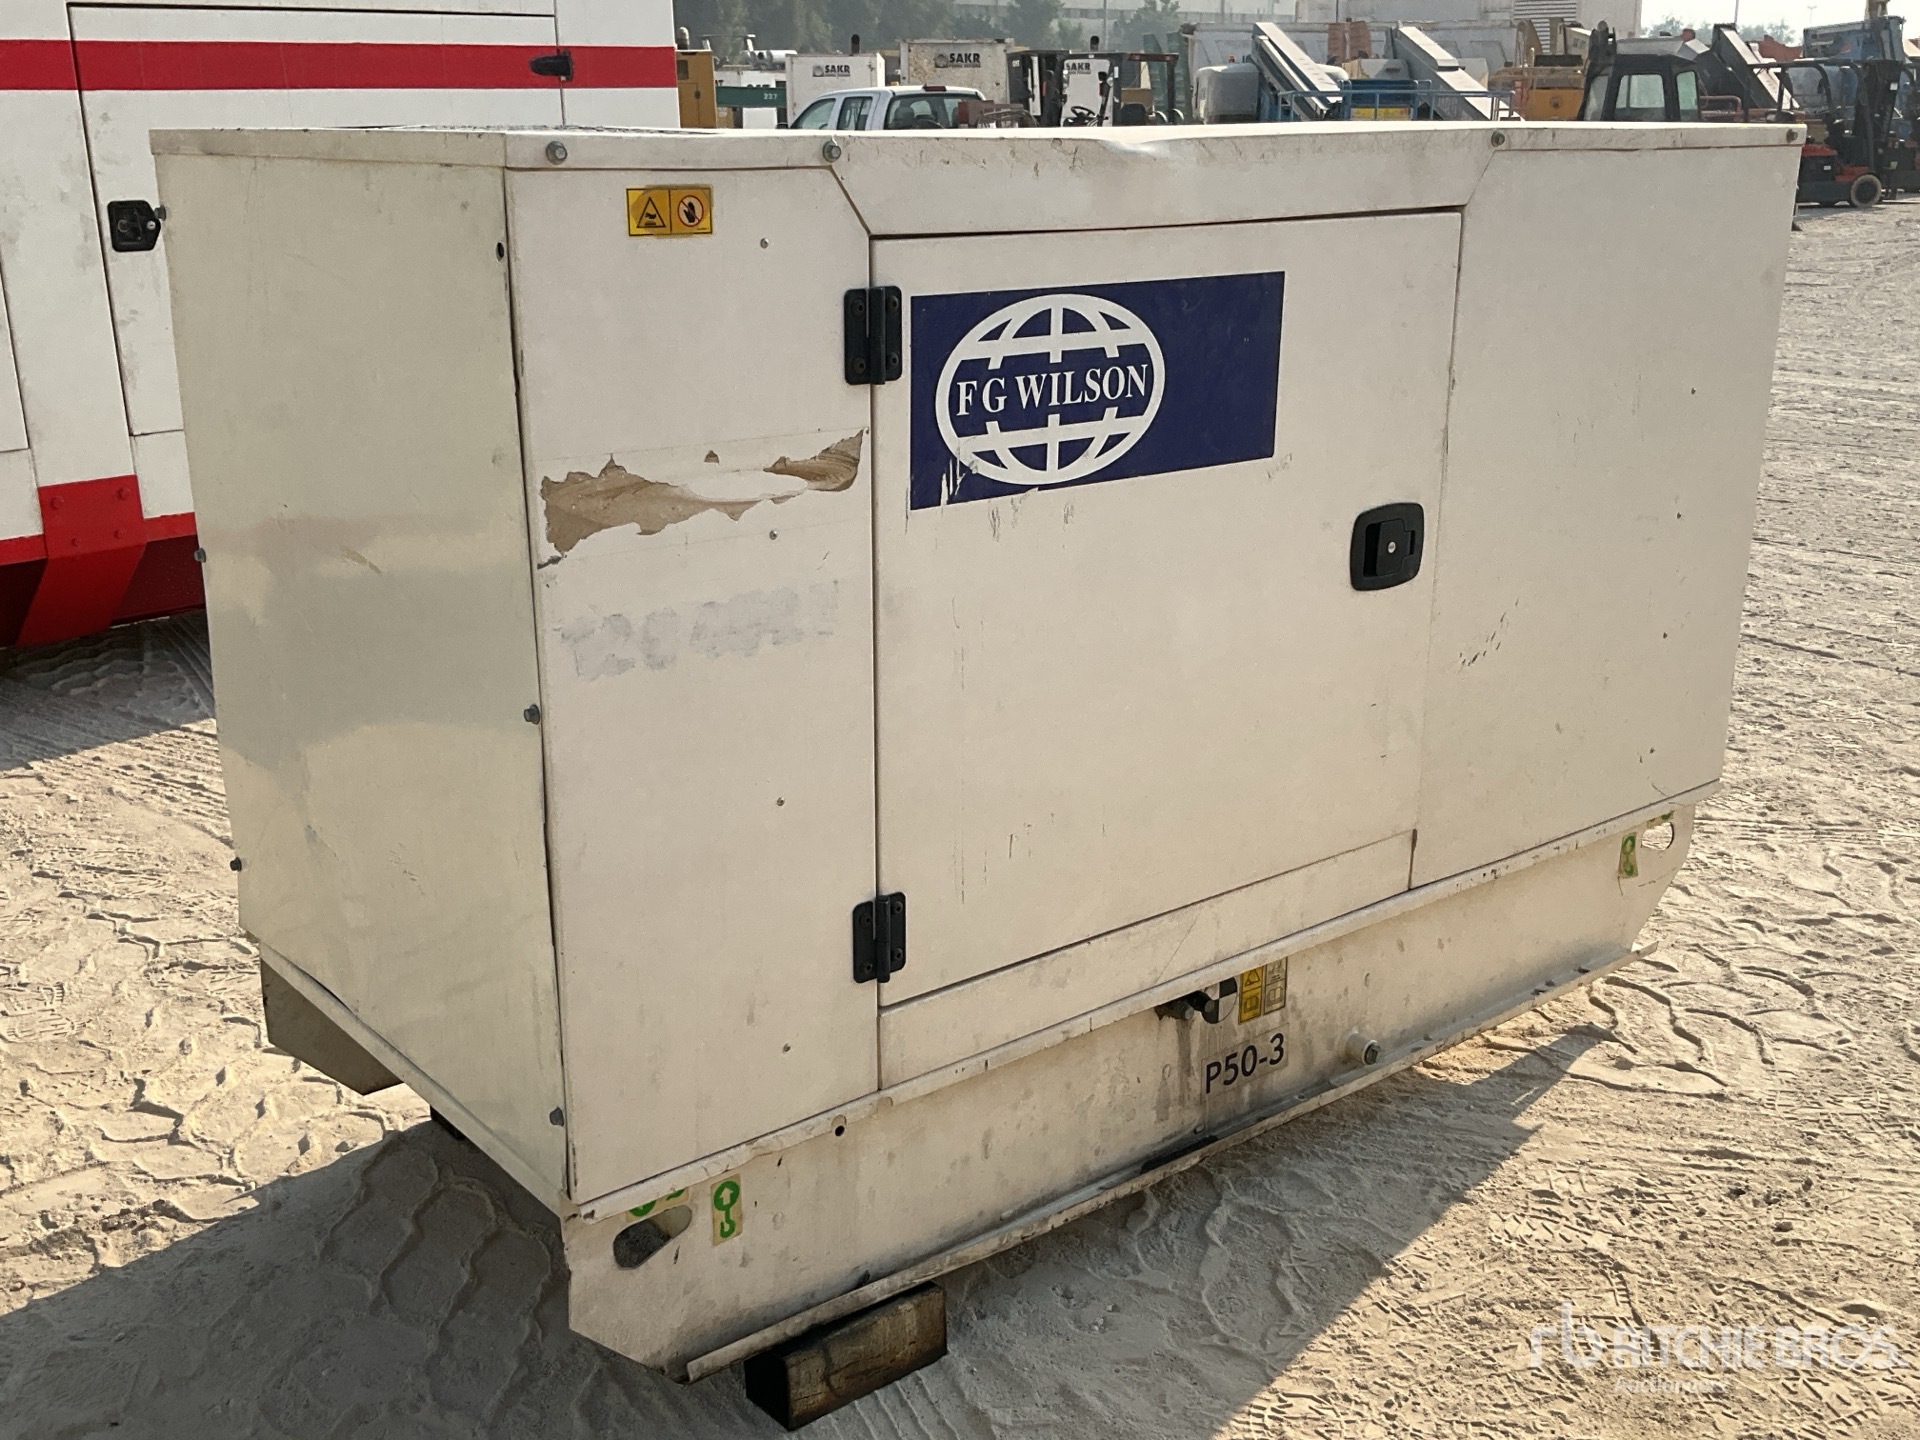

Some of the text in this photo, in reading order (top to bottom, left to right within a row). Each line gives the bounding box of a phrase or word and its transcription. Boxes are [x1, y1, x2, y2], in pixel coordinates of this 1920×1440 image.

[825, 64, 851, 73] SAKR
[949, 53, 980, 63] SAKR
[1015, 363, 1149, 410] WILSON
[1206, 1034, 1284, 1093] P50-3
